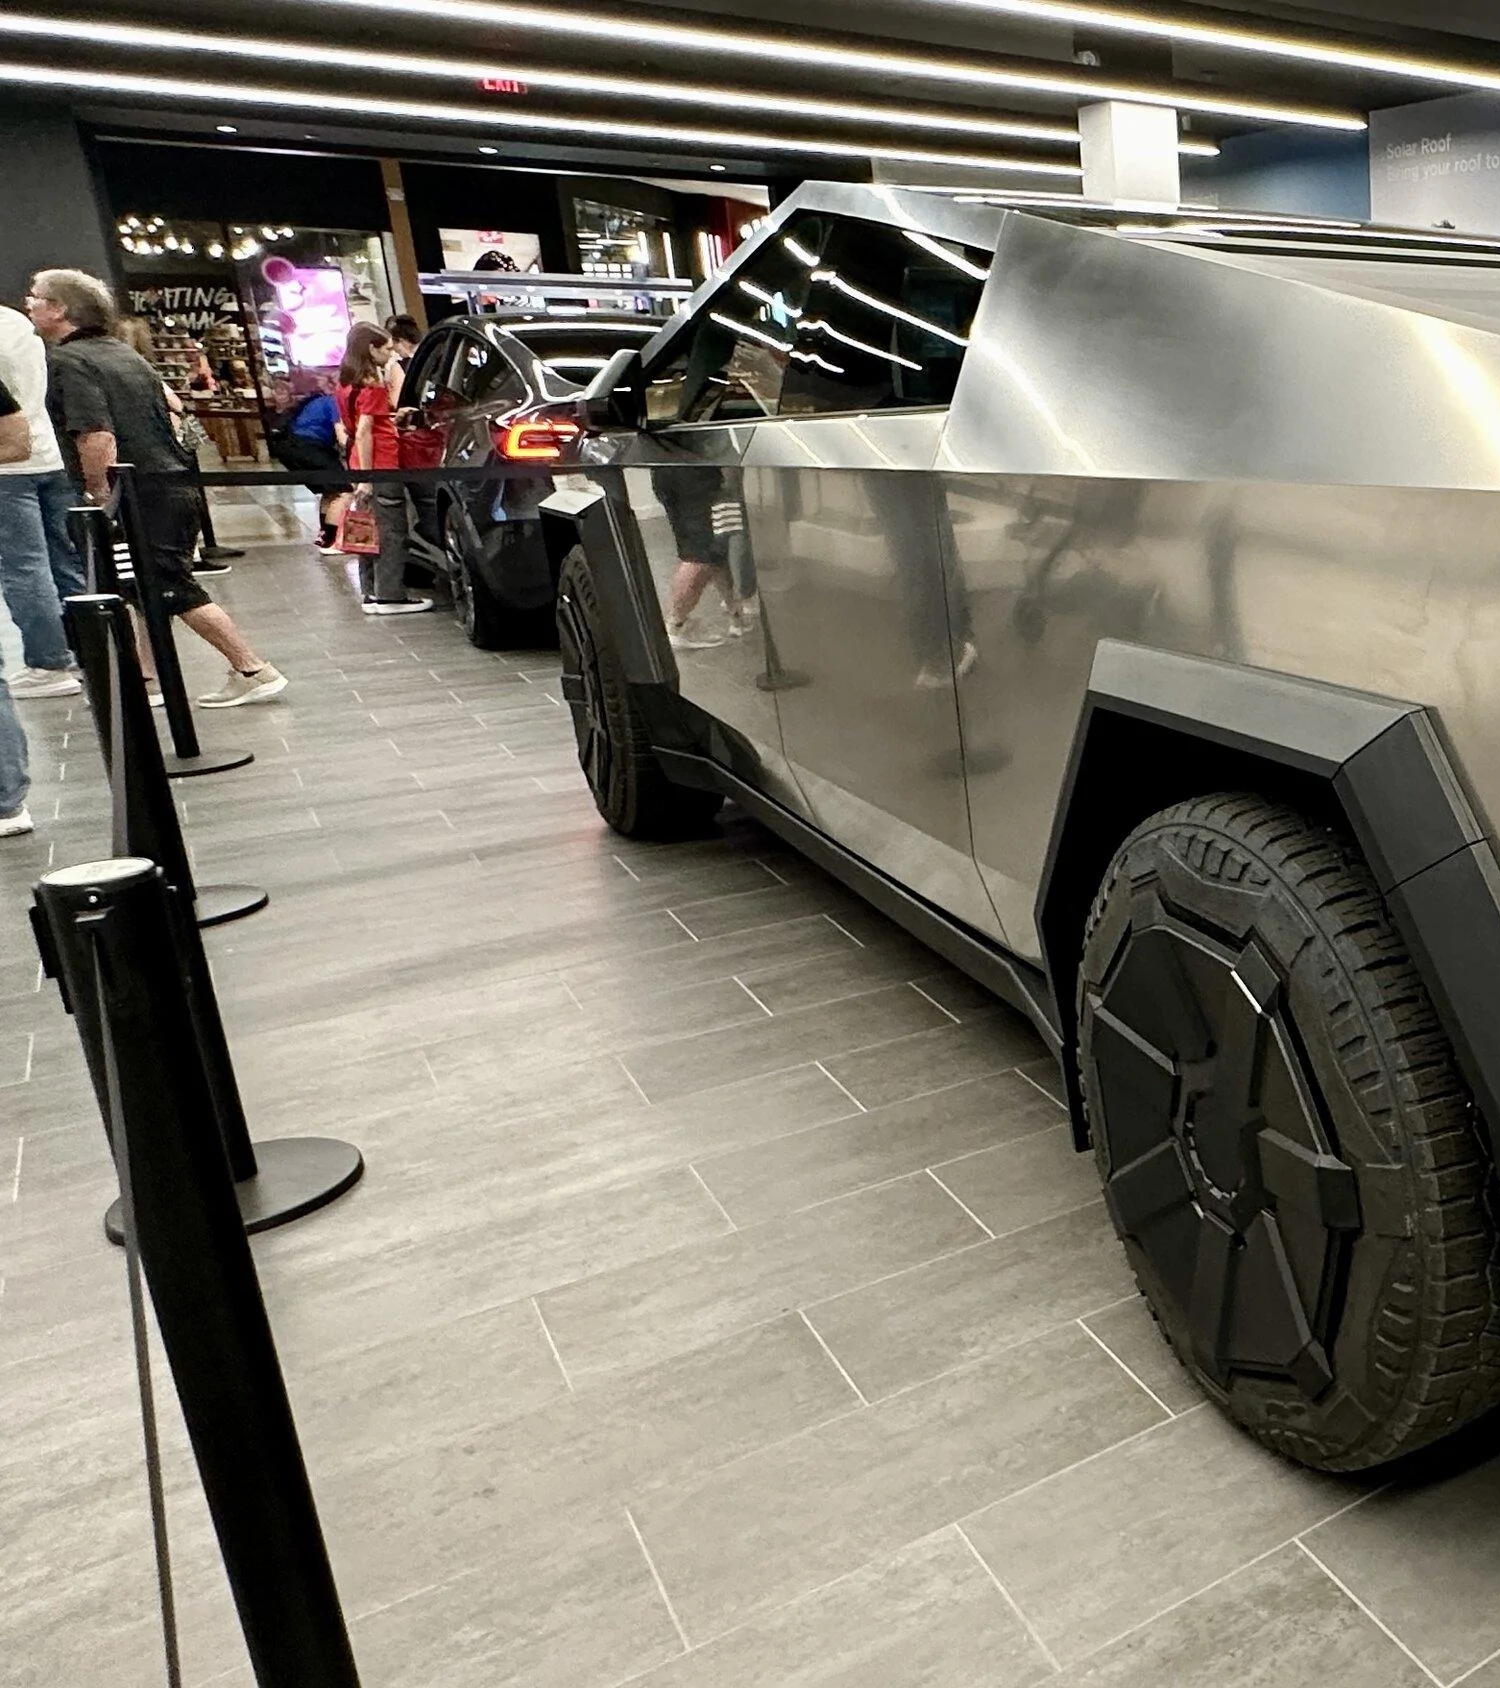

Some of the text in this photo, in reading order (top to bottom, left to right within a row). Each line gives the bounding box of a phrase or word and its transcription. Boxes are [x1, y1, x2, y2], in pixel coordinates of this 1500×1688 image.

[1386, 132, 1451, 160] Solar Roof
[1420, 161, 1451, 181] your
[1454, 152, 1481, 173] roof
[1486, 153, 1500, 169] to
